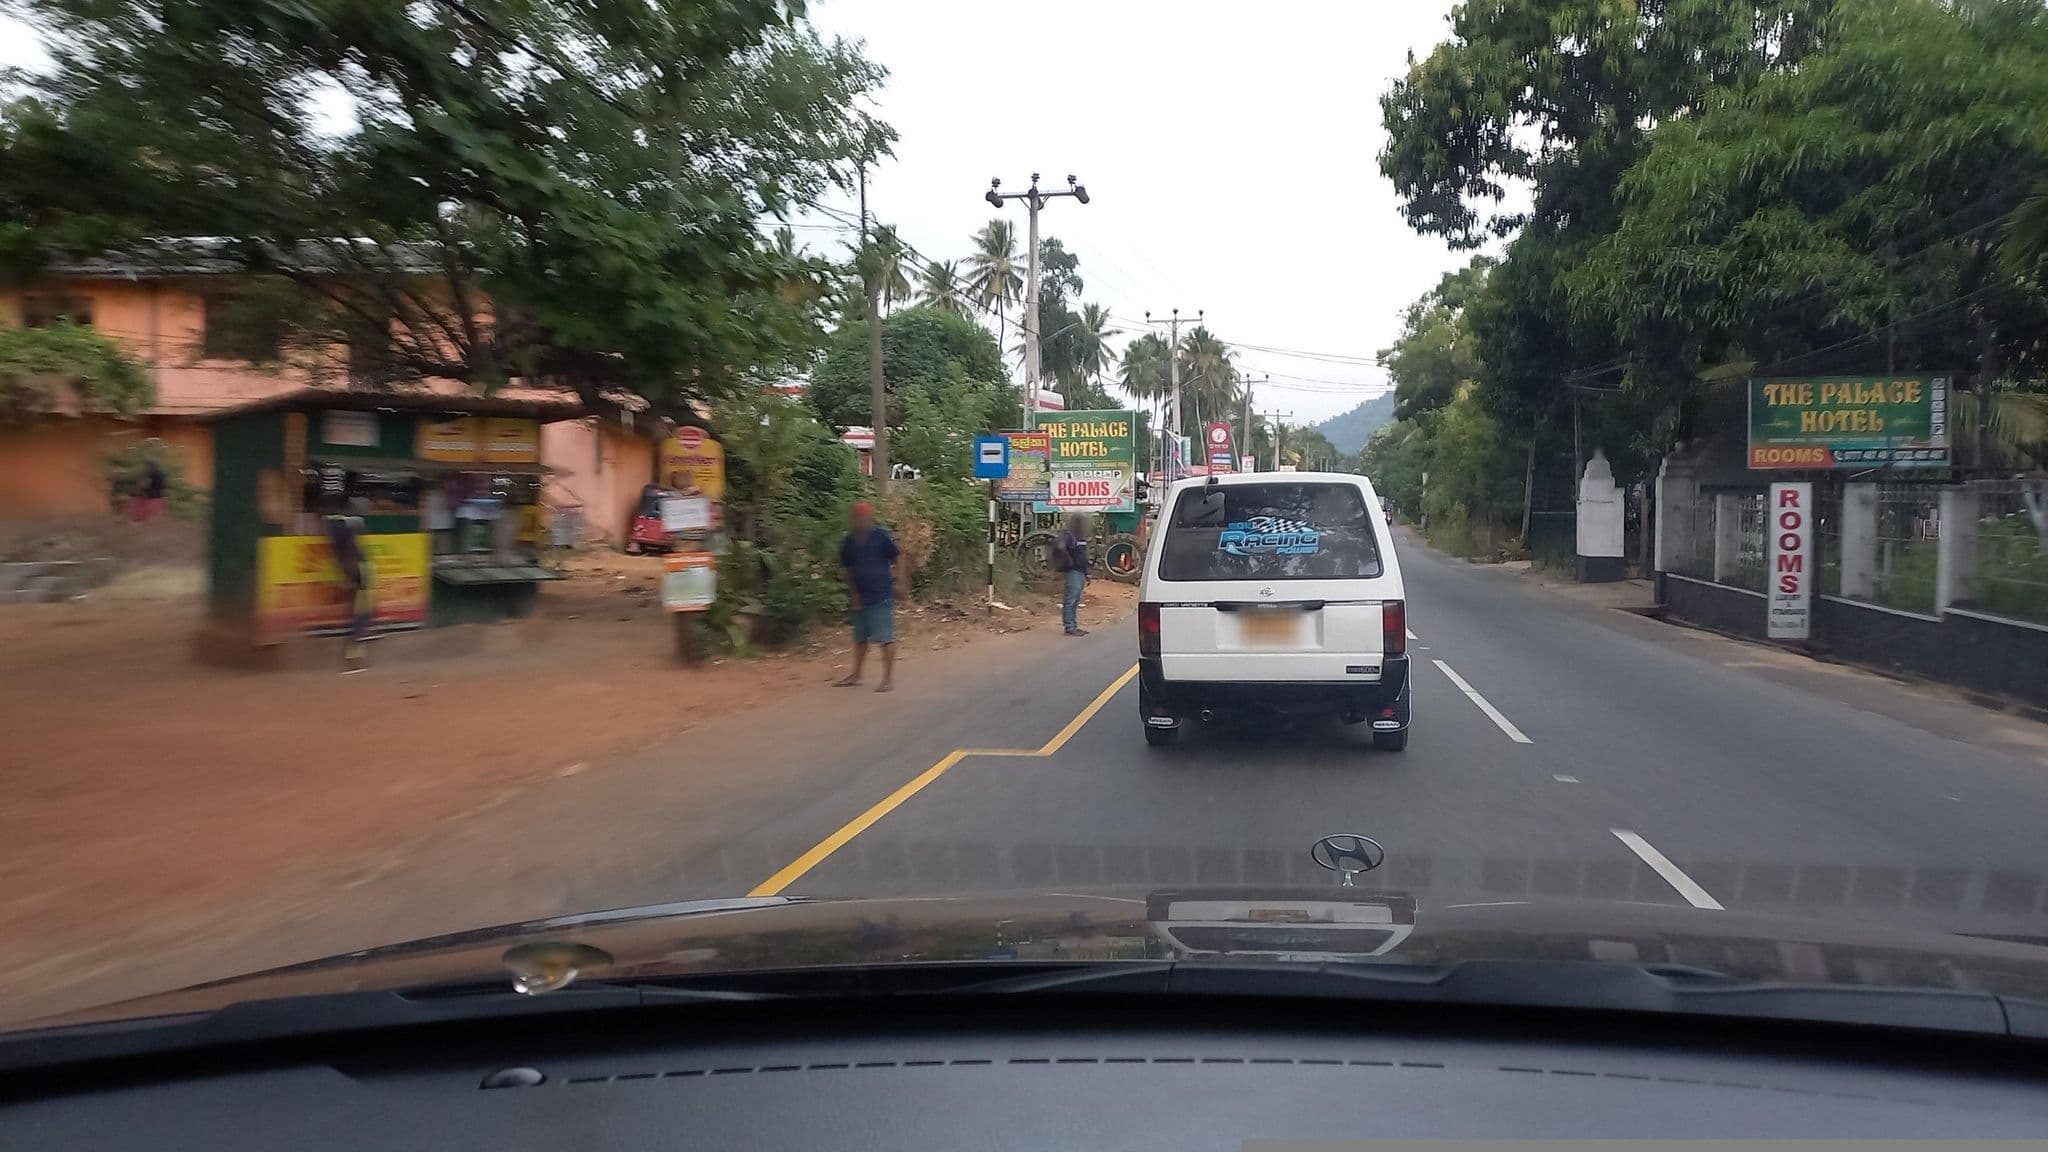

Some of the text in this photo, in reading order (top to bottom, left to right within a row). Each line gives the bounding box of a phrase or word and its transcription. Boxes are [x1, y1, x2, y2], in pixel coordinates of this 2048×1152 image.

[1763, 380, 1922, 406] THE PALACE
[1039, 421, 1128, 438] THE PALACE
[1800, 409, 1884, 433] HOTEL
[1060, 441, 1108, 457] HOTEL
[1754, 448, 1824, 464] ROOMS
[1057, 481, 1110, 497] ROOMS
[1777, 489, 1802, 594] ROOMS
